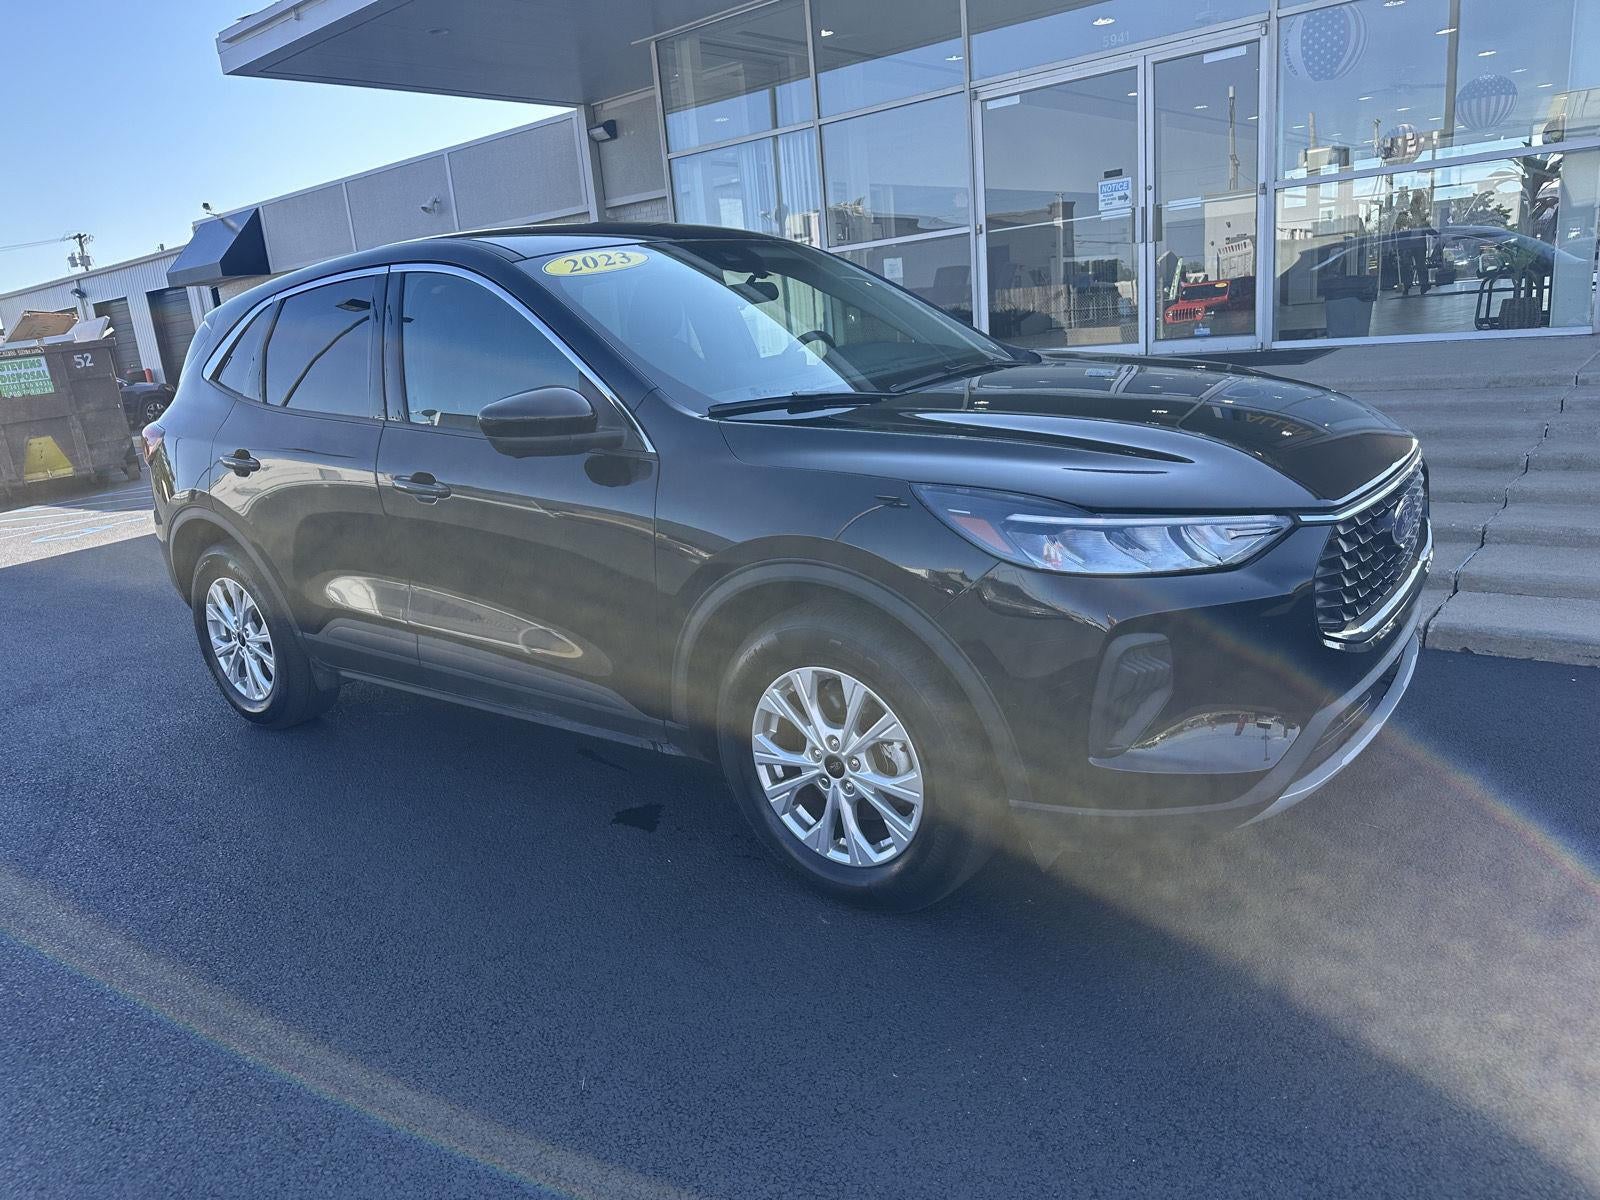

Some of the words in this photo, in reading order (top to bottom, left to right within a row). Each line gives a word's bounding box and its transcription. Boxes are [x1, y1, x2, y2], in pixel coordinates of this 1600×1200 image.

[1103, 31, 1129, 48] 5941
[1102, 181, 1129, 193] NOTICE
[564, 252, 632, 273] 2023
[73, 353, 94, 368] 52
